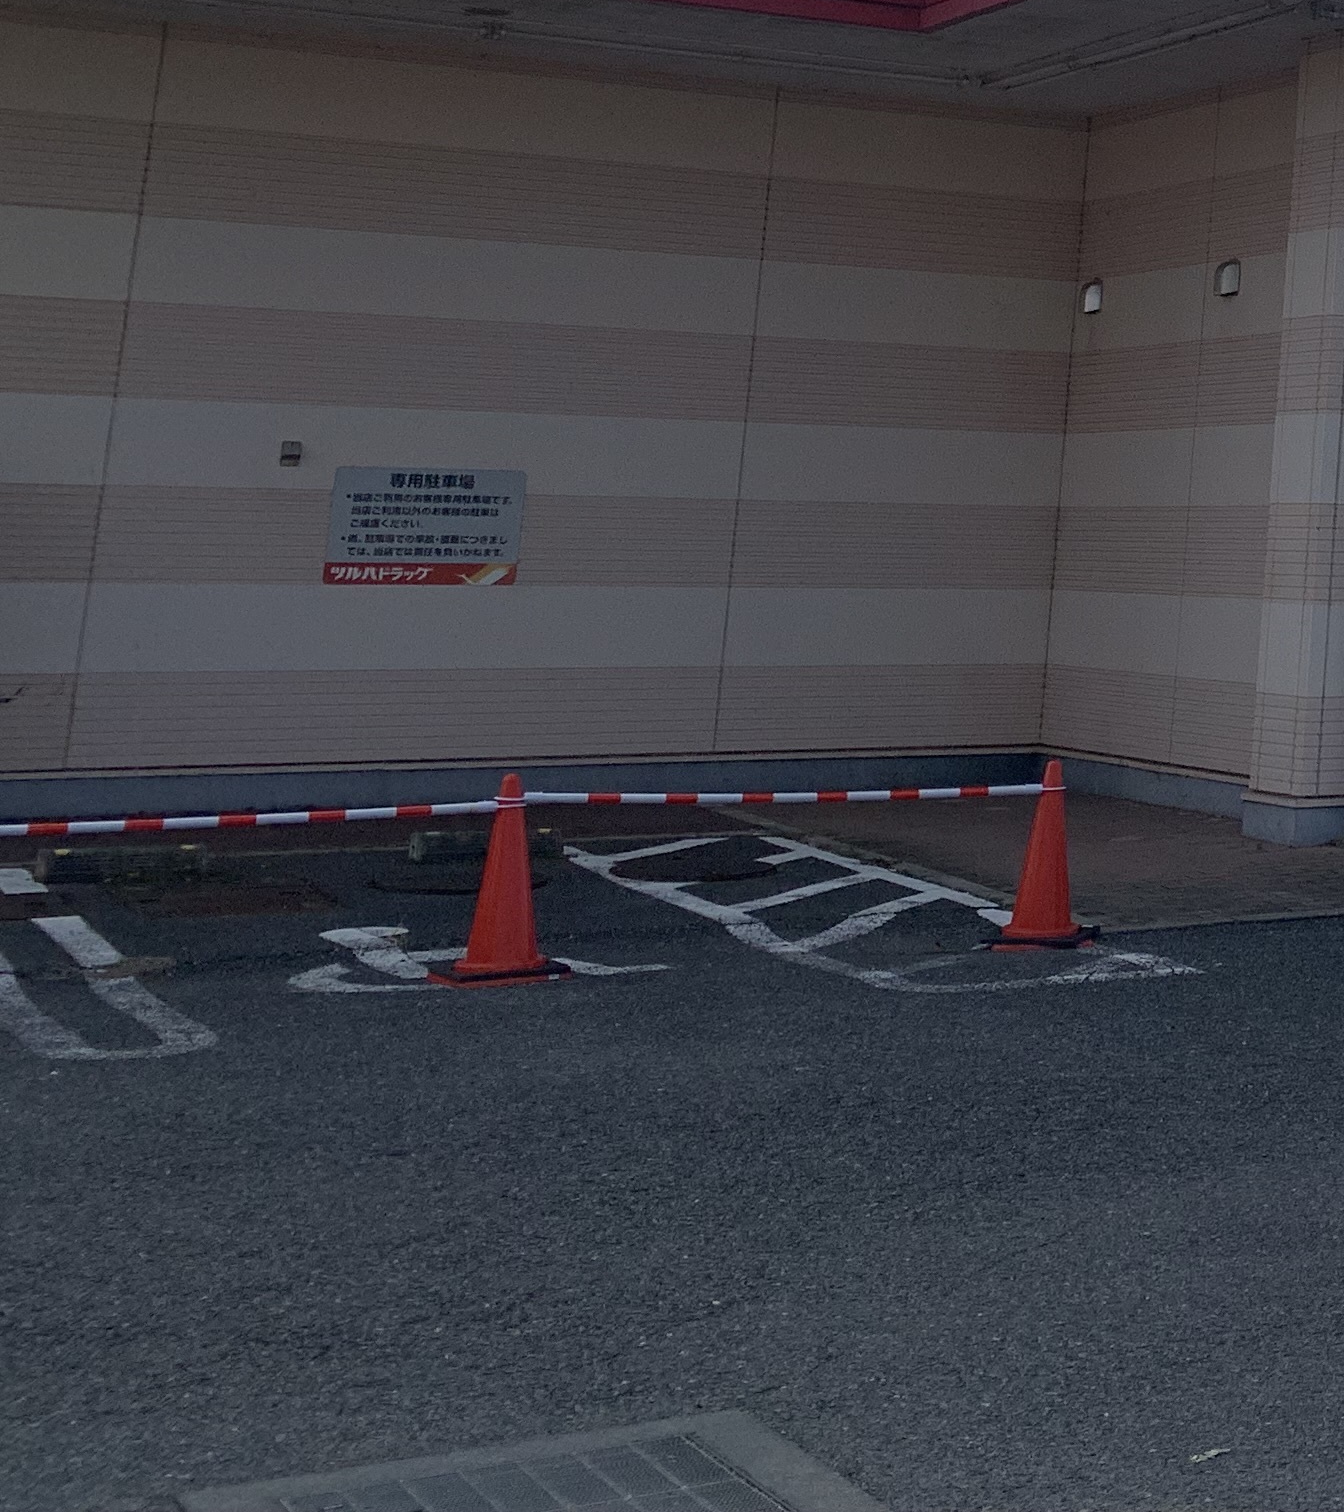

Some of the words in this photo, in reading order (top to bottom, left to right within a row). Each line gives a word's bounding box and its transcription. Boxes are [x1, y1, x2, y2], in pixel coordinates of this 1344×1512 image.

[390, 473, 475, 489] 専用駐車場
[331, 566, 433, 581] ツルハドラッグ
